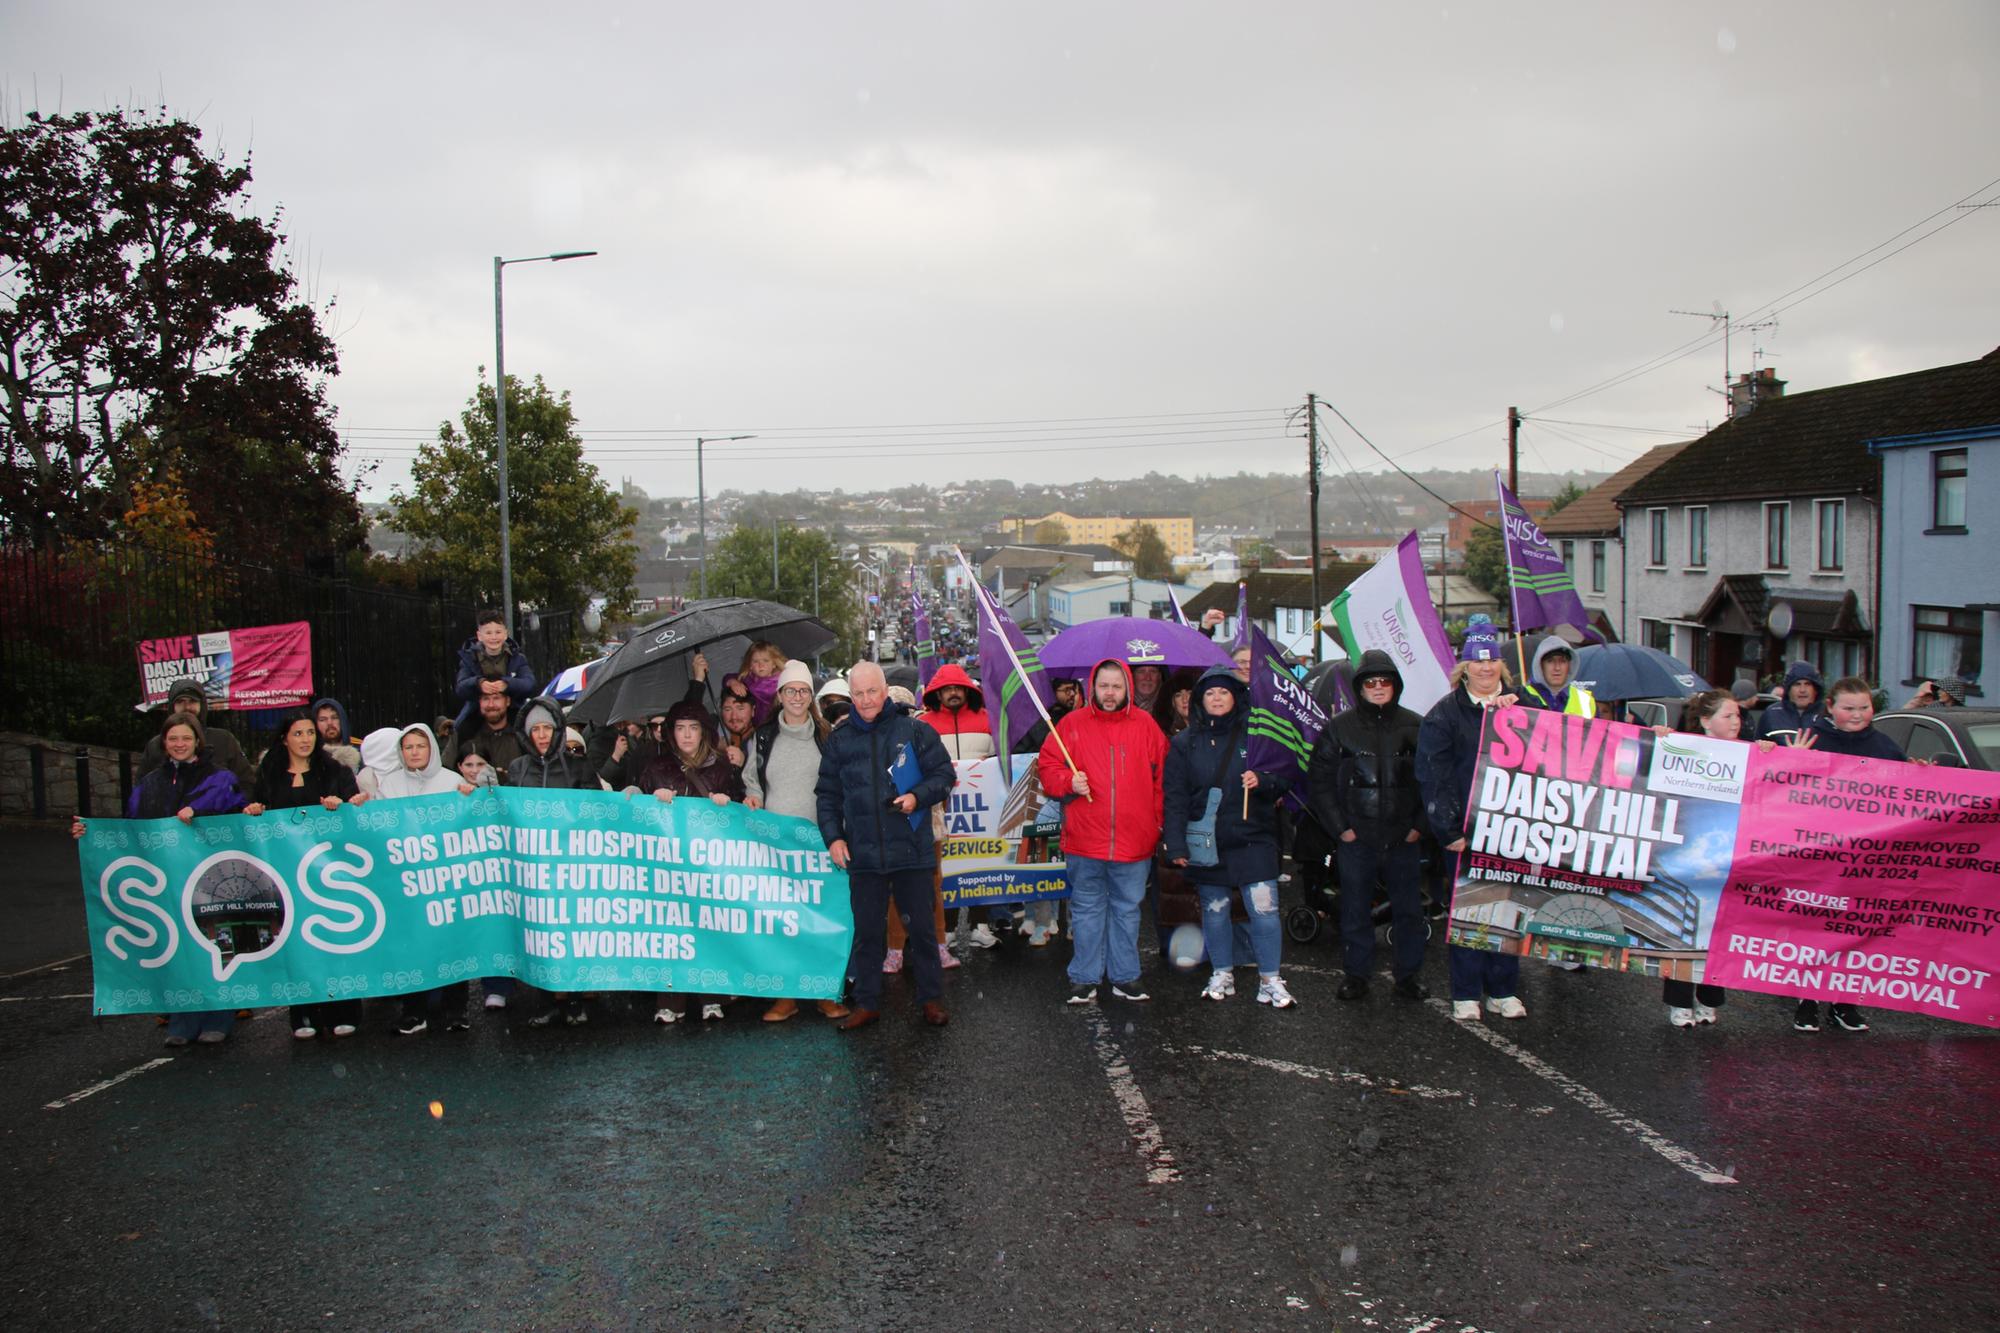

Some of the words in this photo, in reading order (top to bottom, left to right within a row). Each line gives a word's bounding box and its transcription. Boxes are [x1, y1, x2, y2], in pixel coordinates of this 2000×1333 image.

[140, 636, 195, 663] SAVE
[1382, 608, 1417, 665] UNISON
[144, 659, 185, 679] DAISY
[186, 656, 218, 674] HILL
[235, 690, 270, 698] REFORM
[241, 698, 266, 706] MEAN
[1273, 694, 1288, 705] the
[1662, 755, 1737, 779] UNISON
[1663, 776, 1706, 792] Northern
[1706, 783, 1740, 796] Ireland
[1762, 768, 1822, 790] ACUTE
[1825, 777, 1899, 800] STROKE
[1903, 788, 1992, 810] SERVICES
[1479, 767, 1598, 835] DAISY
[1600, 787, 1684, 844] HILL
[1788, 790, 1881, 814] REMOVED
[1886, 802, 1905, 817] IN
[1911, 806, 1954, 823] MAY
[795, 825, 822, 844] SO
[1036, 823, 1057, 833] DAISY
[386, 834, 439, 866] SOS
[443, 825, 512, 858] DAISY
[515, 828, 563, 858] HILL
[568, 829, 684, 865] HOSPITAL
[688, 838, 835, 874] COMMITTEE
[941, 840, 1003, 857] SERVICES
[1471, 811, 1656, 882] HOSPITAL
[1794, 829, 1844, 848] THEN
[1849, 836, 1888, 851] YOU
[1891, 841, 1980, 855] REMOVED
[1750, 839, 1861, 865] EMERGENCY
[1864, 853, 1943, 868] GENERAL
[1945, 858, 2000, 874] SURGE
[400, 858, 511, 897] SUPPORT
[513, 859, 551, 891] THE
[556, 862, 650, 893] FUTURE
[653, 867, 824, 905] DEVELOPMENT
[958, 875, 1003, 885] Supported
[1004, 874, 1015, 884] by
[1468, 867, 1485, 880] AT
[1486, 869, 1521, 884] DAISY
[1522, 874, 1548, 888] HILL
[1550, 877, 1605, 896] HOSPITAL
[1585, 877, 1643, 893] SERVICES
[1839, 867, 1875, 879] JAN
[1879, 868, 1919, 881] 2024
[960, 884, 1003, 898] Indian
[1006, 882, 1034, 895] Arts
[1037, 879, 1066, 893] Club
[1735, 882, 1782, 896] NOW
[1783, 887, 1850, 910] YOU'RE
[1853, 897, 1979, 918] THREATENING
[100, 841, 386, 982] SOS
[200, 903, 224, 913] DAISY
[226, 902, 243, 911] HILL
[245, 900, 279, 910] HOSPITAL
[425, 896, 458, 927] OF
[461, 889, 522, 921] DAISY
[524, 896, 571, 926] HILL
[575, 897, 694, 929] HOSPITAL
[698, 905, 748, 935] AND
[752, 909, 800, 938] IT'S
[1743, 895, 1786, 913] TAKE
[1789, 901, 1843, 920] AWAY
[1845, 911, 1886, 926] OUR
[1888, 913, 1994, 937] MATERNITY
[1541, 924, 1563, 935] DAISY
[1566, 927, 1582, 938] HILL
[1583, 930, 1617, 943] HOSPITAL
[1824, 921, 1897, 938] SERVICE.
[524, 928, 567, 959] NHS
[571, 931, 697, 961] WORKERS
[1728, 934, 1843, 968] REFORM
[1845, 951, 1921, 977] DOES
[1925, 961, 1991, 990] NOT
[1743, 960, 1823, 989] MEAN
[1828, 972, 1961, 1010] REMOVAL
